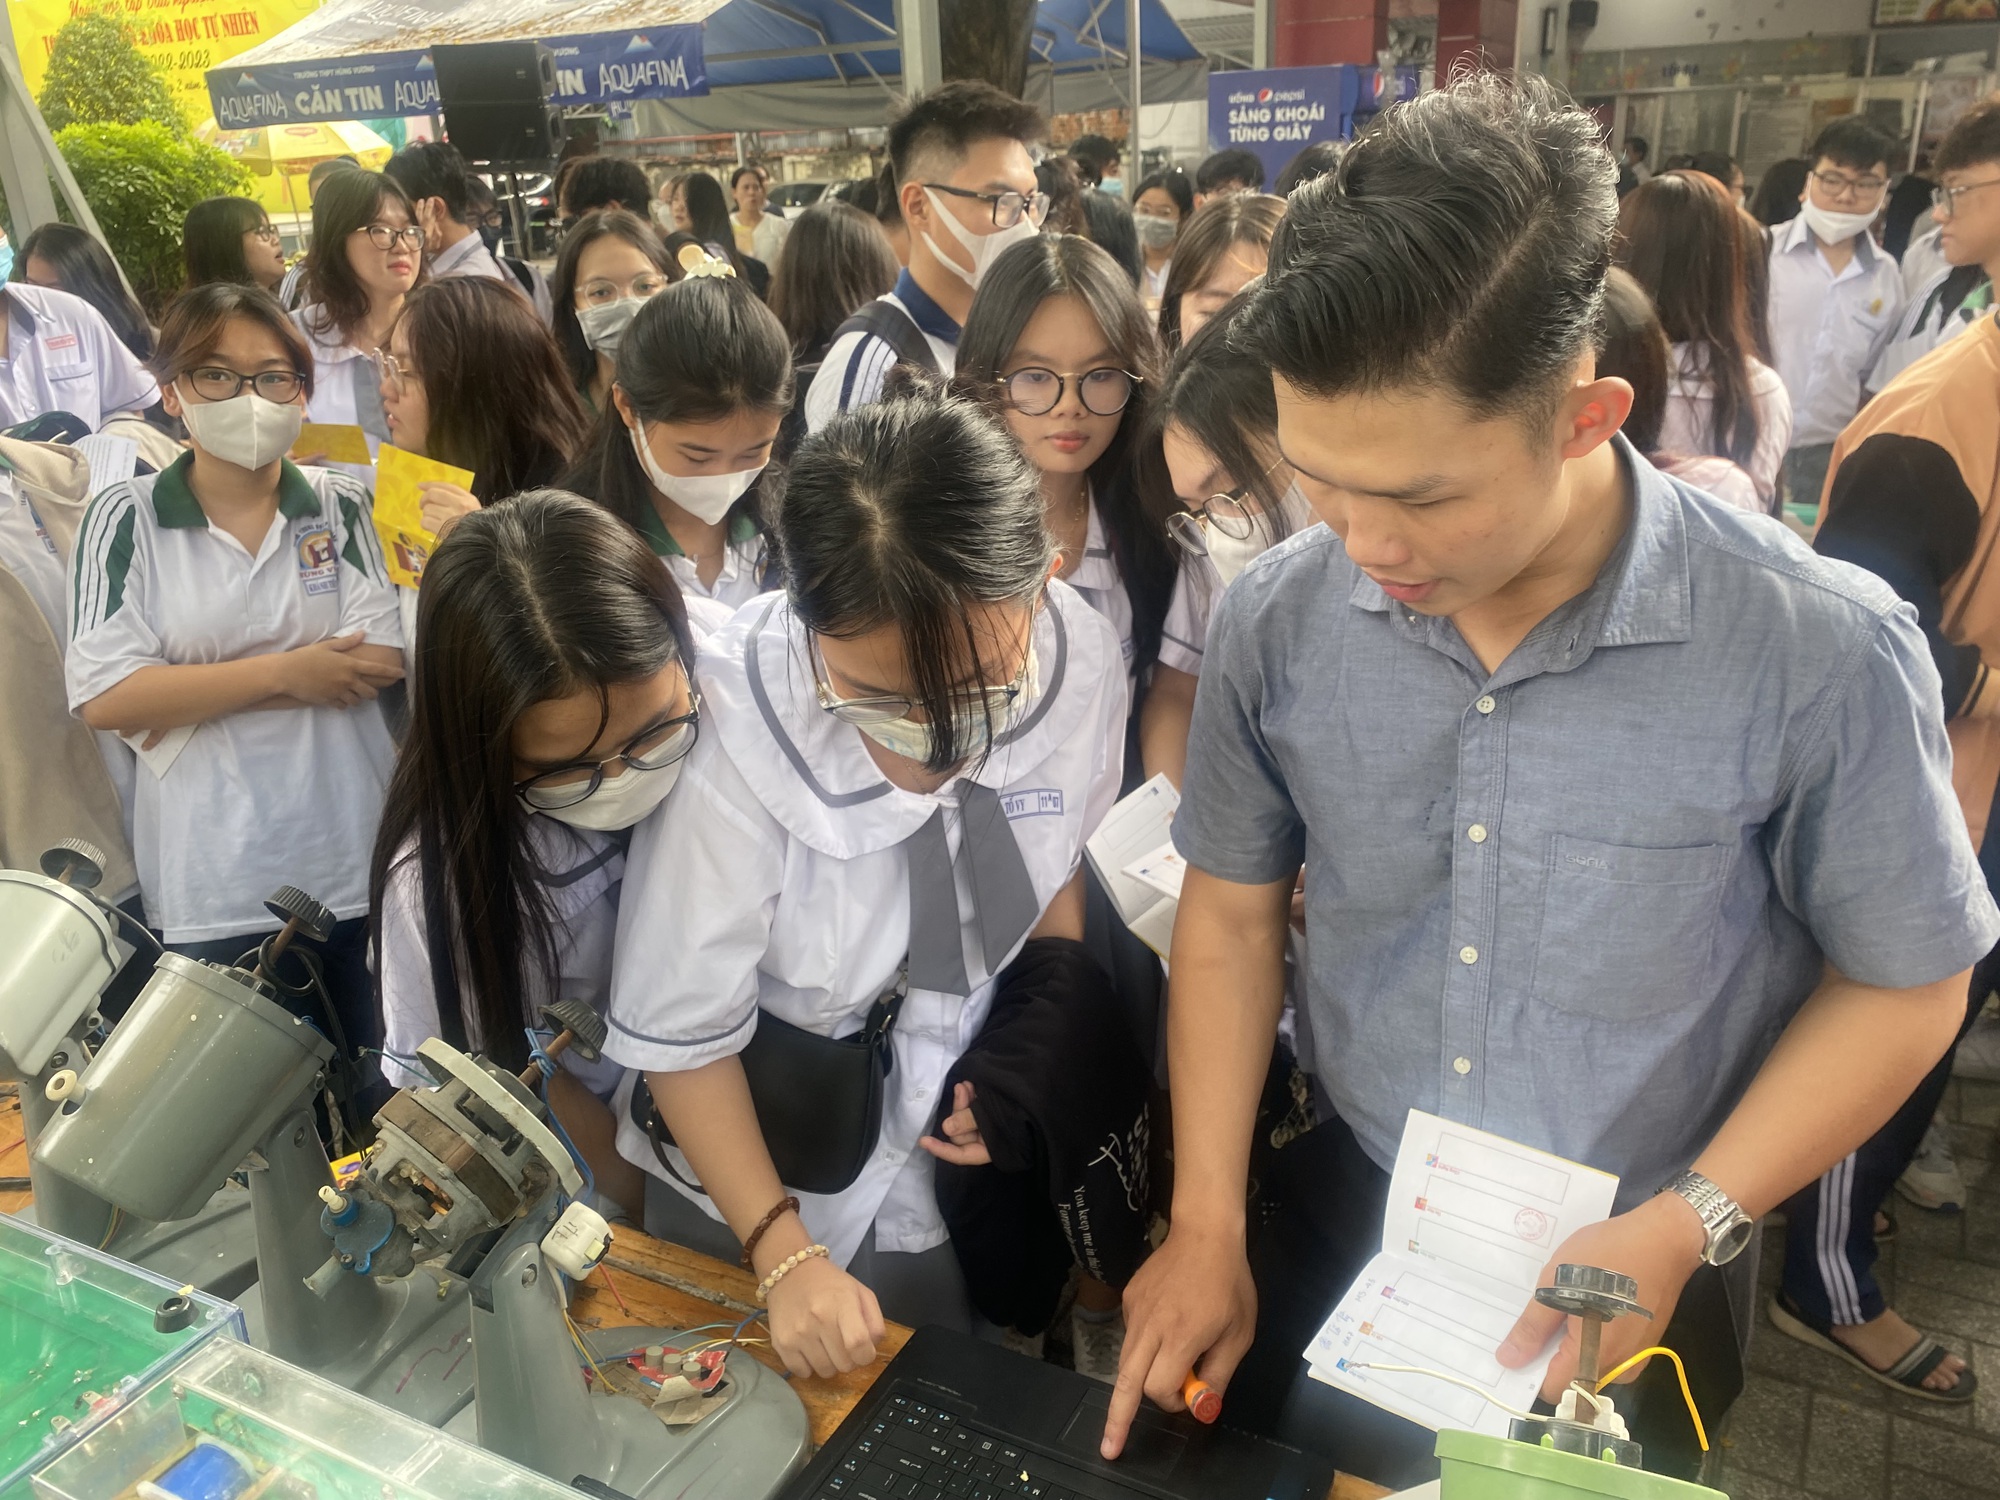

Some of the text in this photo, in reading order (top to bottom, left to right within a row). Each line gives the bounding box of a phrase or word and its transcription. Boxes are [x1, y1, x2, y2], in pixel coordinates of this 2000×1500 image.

[175, 18, 201, 45] HỌC
[202, 14, 219, 42] TỰ
[222, 7, 260, 36] NHIÊN
[556, 68, 587, 96] IN
[598, 55, 690, 97] AQUAFINA
[295, 84, 385, 115] CĂN TIN
[394, 79, 441, 112] AQUA
[1273, 88, 1305, 104] pepsi
[219, 90, 289, 125] AQUAFINA
[1275, 101, 1325, 122] KHOÁI
[1228, 122, 1312, 143] TỪNG GIÂY
[1015, 799, 1025, 811] VY
[1074, 1185, 1086, 1208] You
[1078, 1208, 1090, 1231] keep
[1082, 1232, 1094, 1246] me
